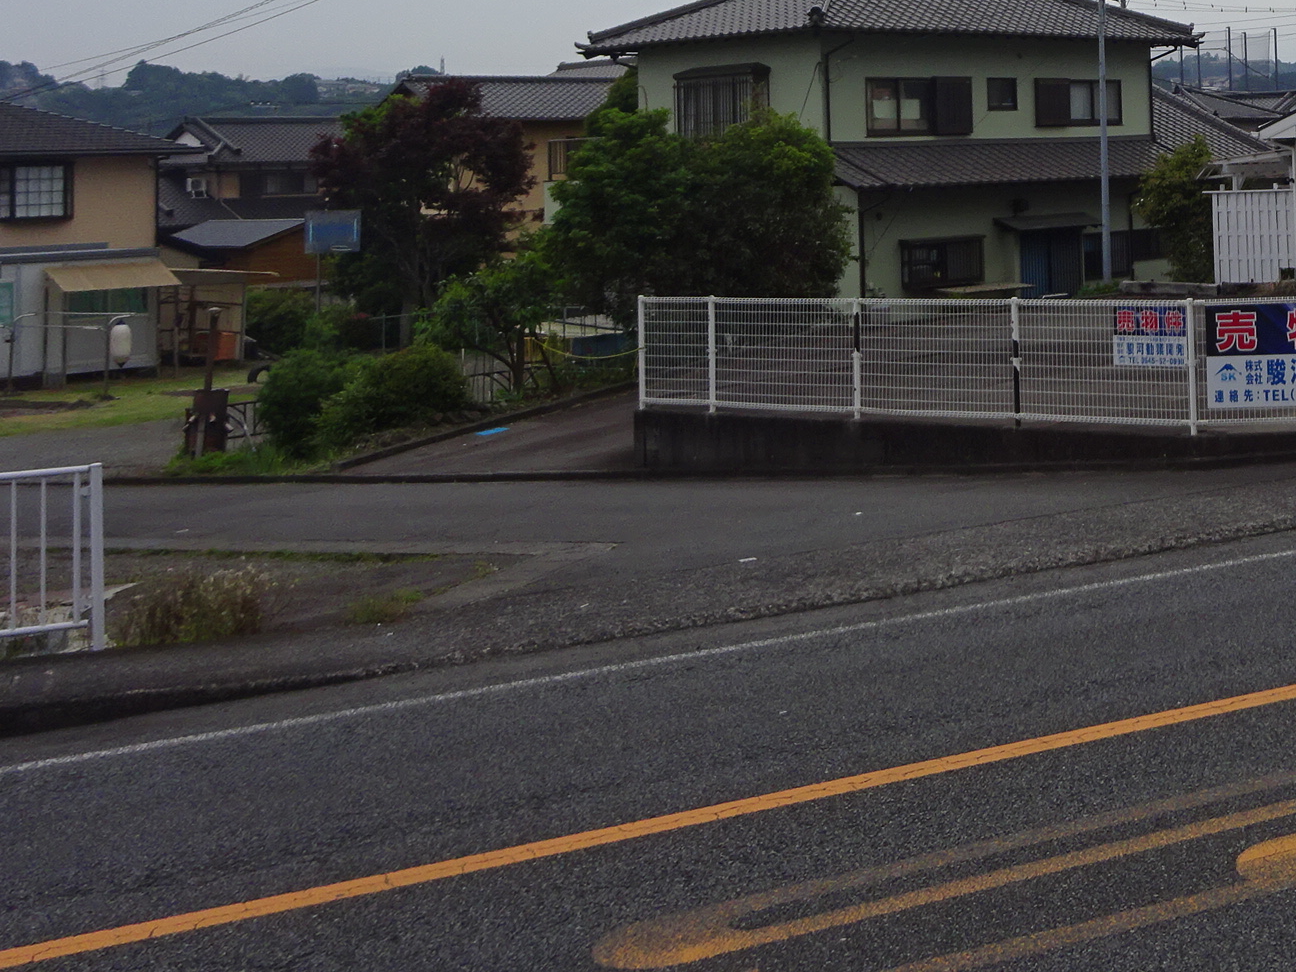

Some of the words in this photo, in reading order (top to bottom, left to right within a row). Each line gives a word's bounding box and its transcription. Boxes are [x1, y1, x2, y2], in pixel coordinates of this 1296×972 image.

[1116, 310, 1183, 333] 売物件
[1245, 359, 1263, 373] 株式
[1220, 372, 1237, 382] SK
[1245, 372, 1263, 385] 会社
